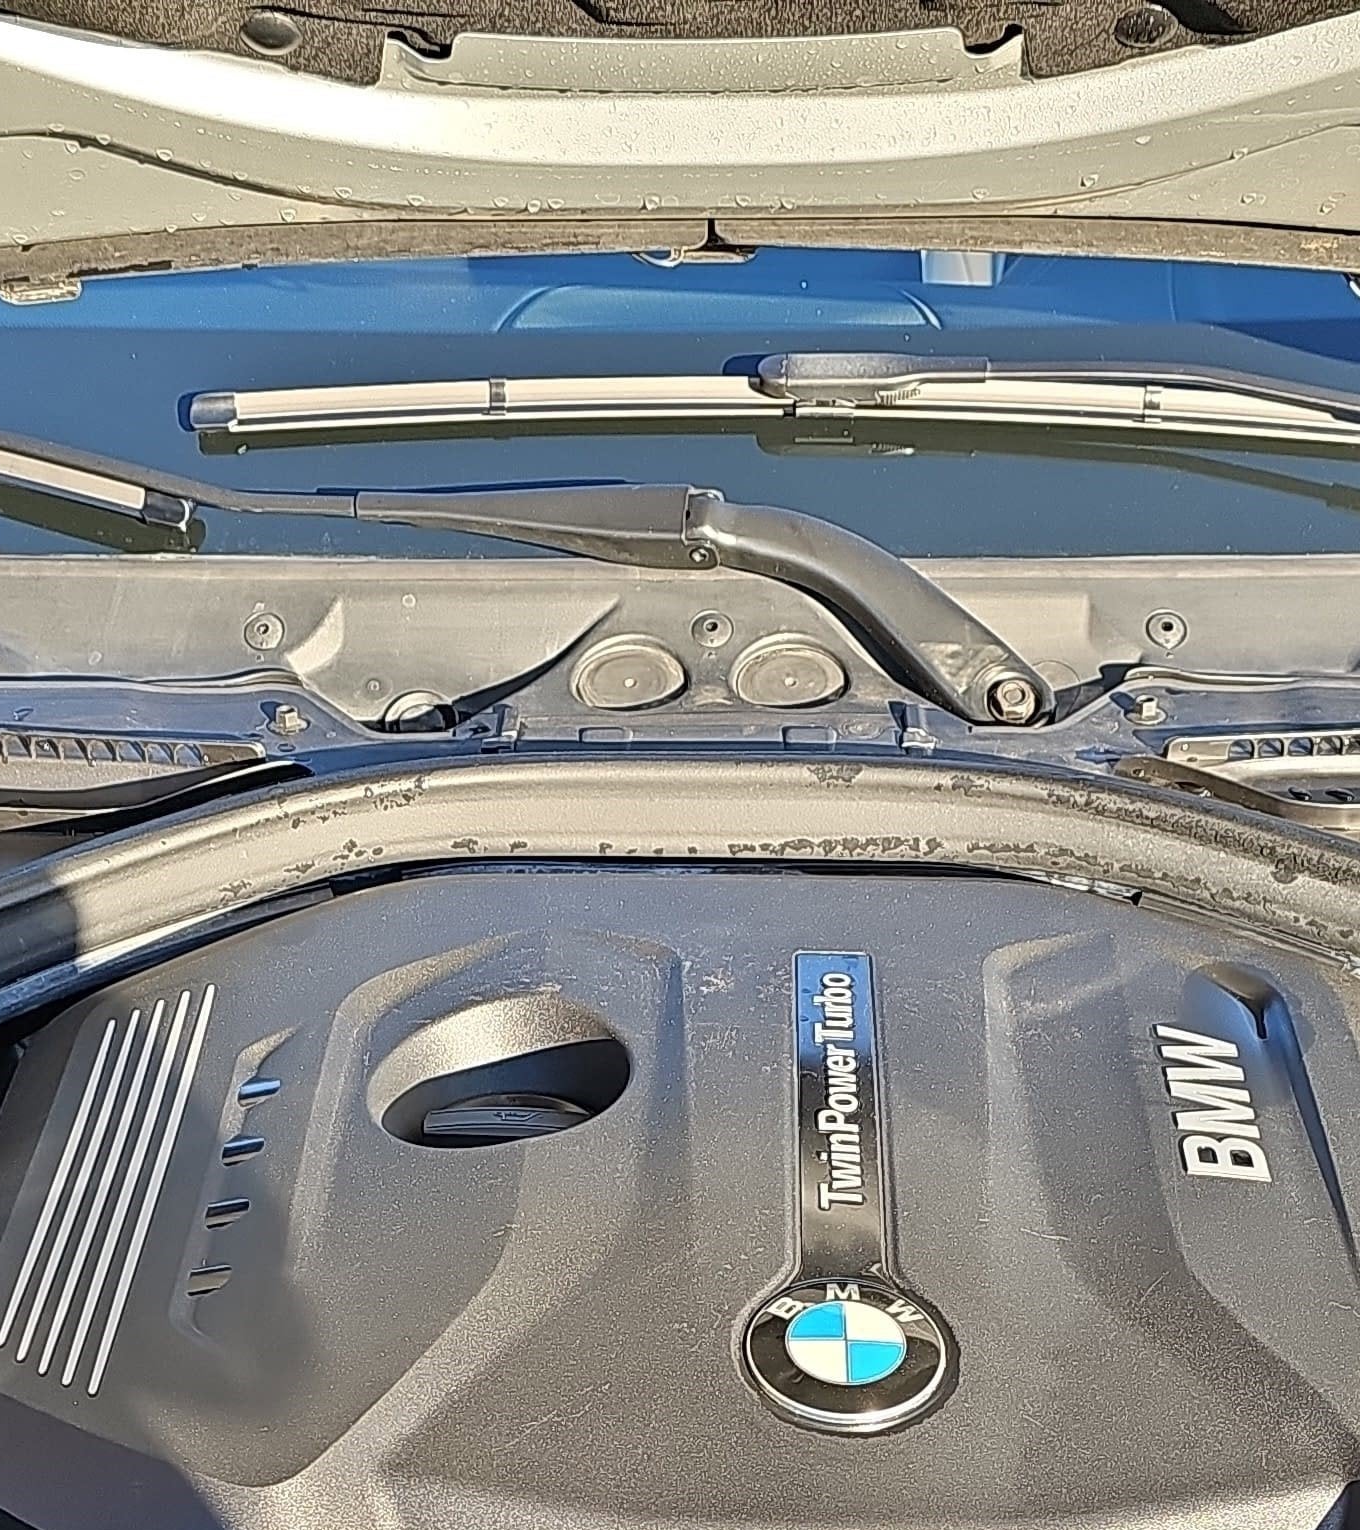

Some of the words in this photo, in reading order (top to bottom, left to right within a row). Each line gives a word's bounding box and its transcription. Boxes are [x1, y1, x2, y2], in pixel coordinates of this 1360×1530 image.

[812, 971, 857, 1044] Turbo
[817, 1044, 864, 1211] TwinPower
[1153, 1024, 1272, 1183] BMW
[766, 1283, 924, 1324] BMW
